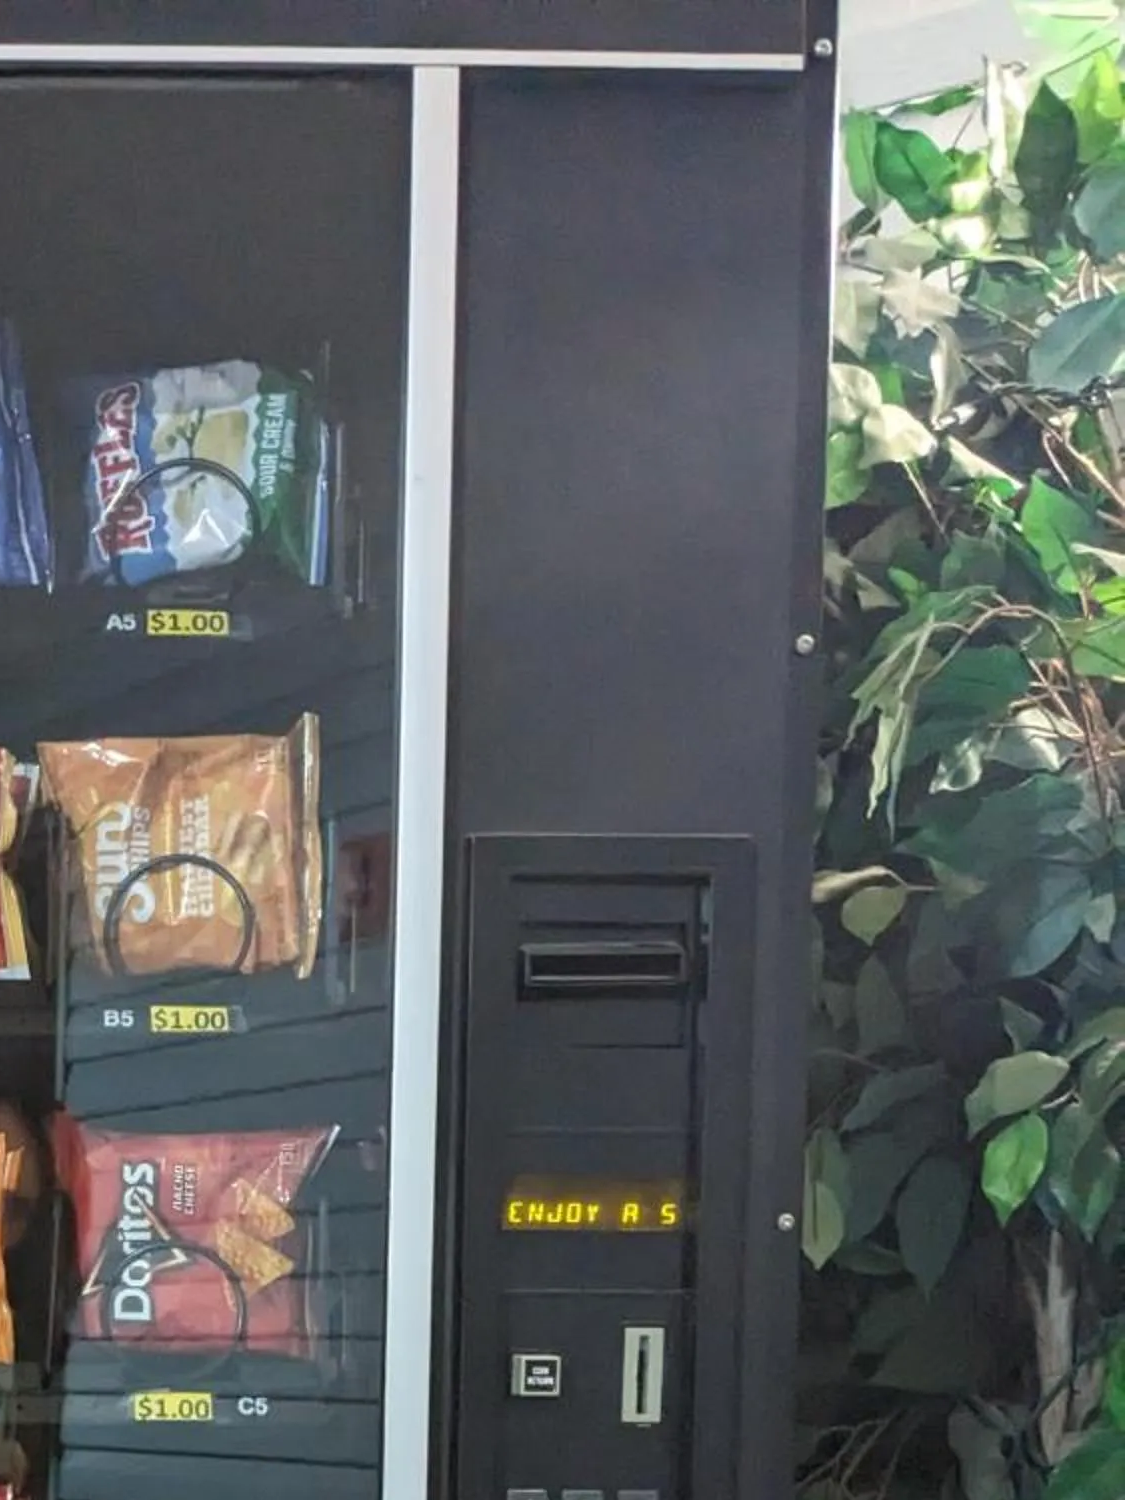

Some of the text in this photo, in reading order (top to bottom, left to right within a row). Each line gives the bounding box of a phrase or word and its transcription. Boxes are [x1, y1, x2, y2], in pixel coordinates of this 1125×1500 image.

[262, 392, 288, 452] CREAM
[106, 612, 225, 633] A5 $1.00
[103, 1009, 226, 1031] B5 $1.00
[173, 1164, 184, 1213] NACHO
[184, 1165, 195, 1215] CHEESE
[507, 1200, 678, 1224] ENJOY A S
[113, 1163, 156, 1322] Doritos
[137, 1397, 269, 1421] $1.00 C5
